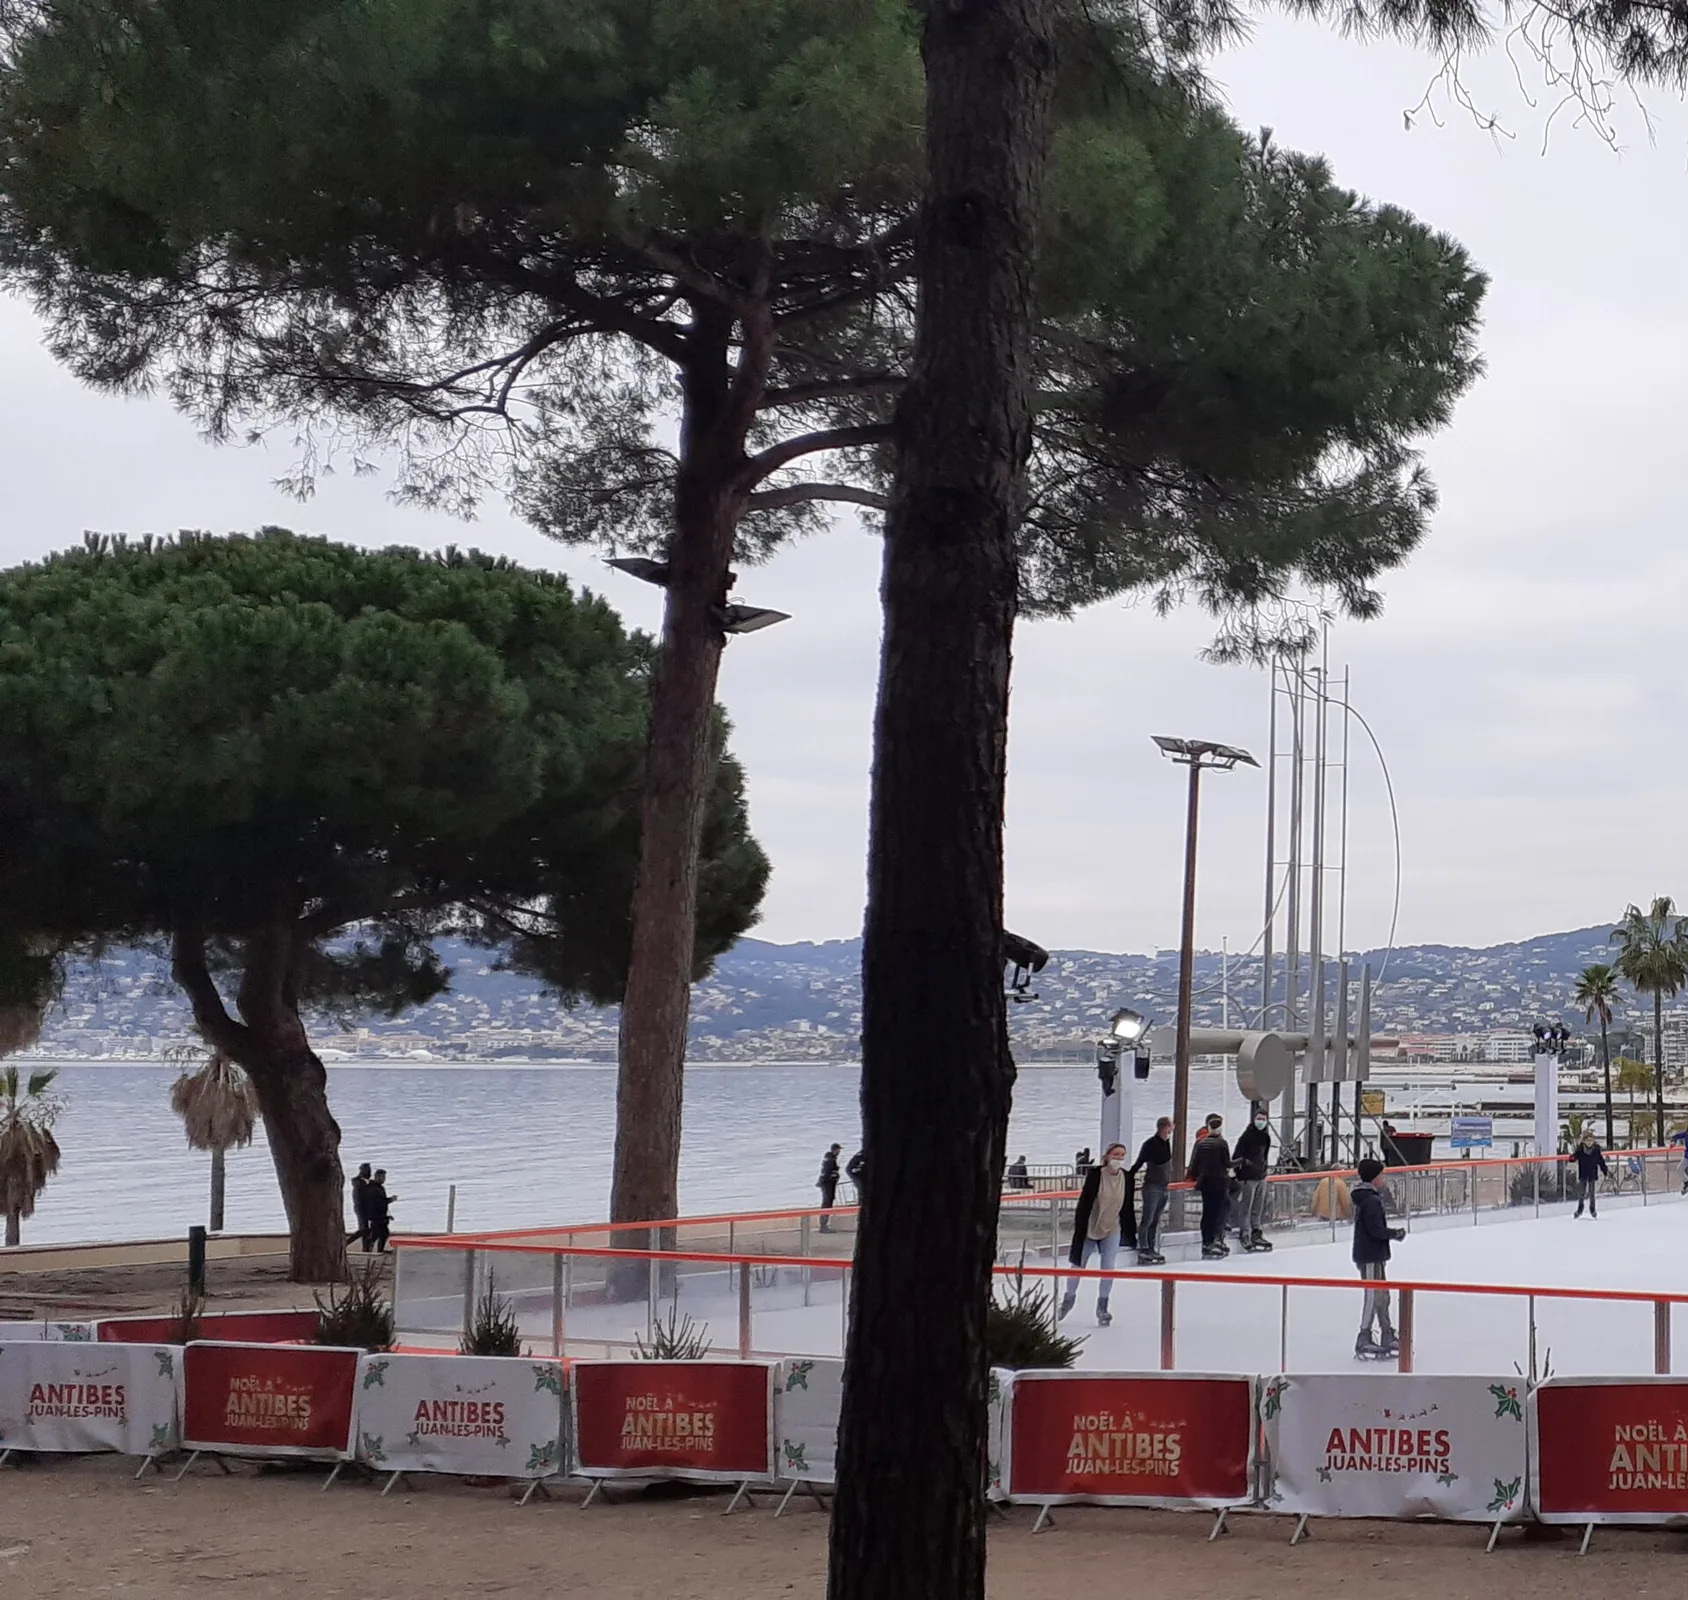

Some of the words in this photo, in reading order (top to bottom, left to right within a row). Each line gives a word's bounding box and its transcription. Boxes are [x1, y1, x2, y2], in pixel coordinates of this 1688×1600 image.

[29, 1383, 125, 1406] ANTIBES
[226, 1392, 312, 1417] ANTIBES
[625, 1392, 660, 1411] NOËL
[27, 1404, 125, 1418] JUAN-LES-PINS
[414, 1399, 505, 1425] ANTIBES
[1073, 1411, 1117, 1431] NOËL
[413, 1422, 505, 1438] JUAN-LES-PINS
[620, 1412, 715, 1436] ANTIBES
[1615, 1419, 1668, 1442] NOËL
[1673, 1418, 1688, 1442] À
[620, 1435, 714, 1451] JUAN-LES-PINS
[1067, 1432, 1182, 1460] ANTIBES
[1325, 1427, 1450, 1457] ANTIBES
[1065, 1458, 1181, 1476] JUAN-LES-PINS
[1323, 1455, 1451, 1474] JUAN-LES-PINS
